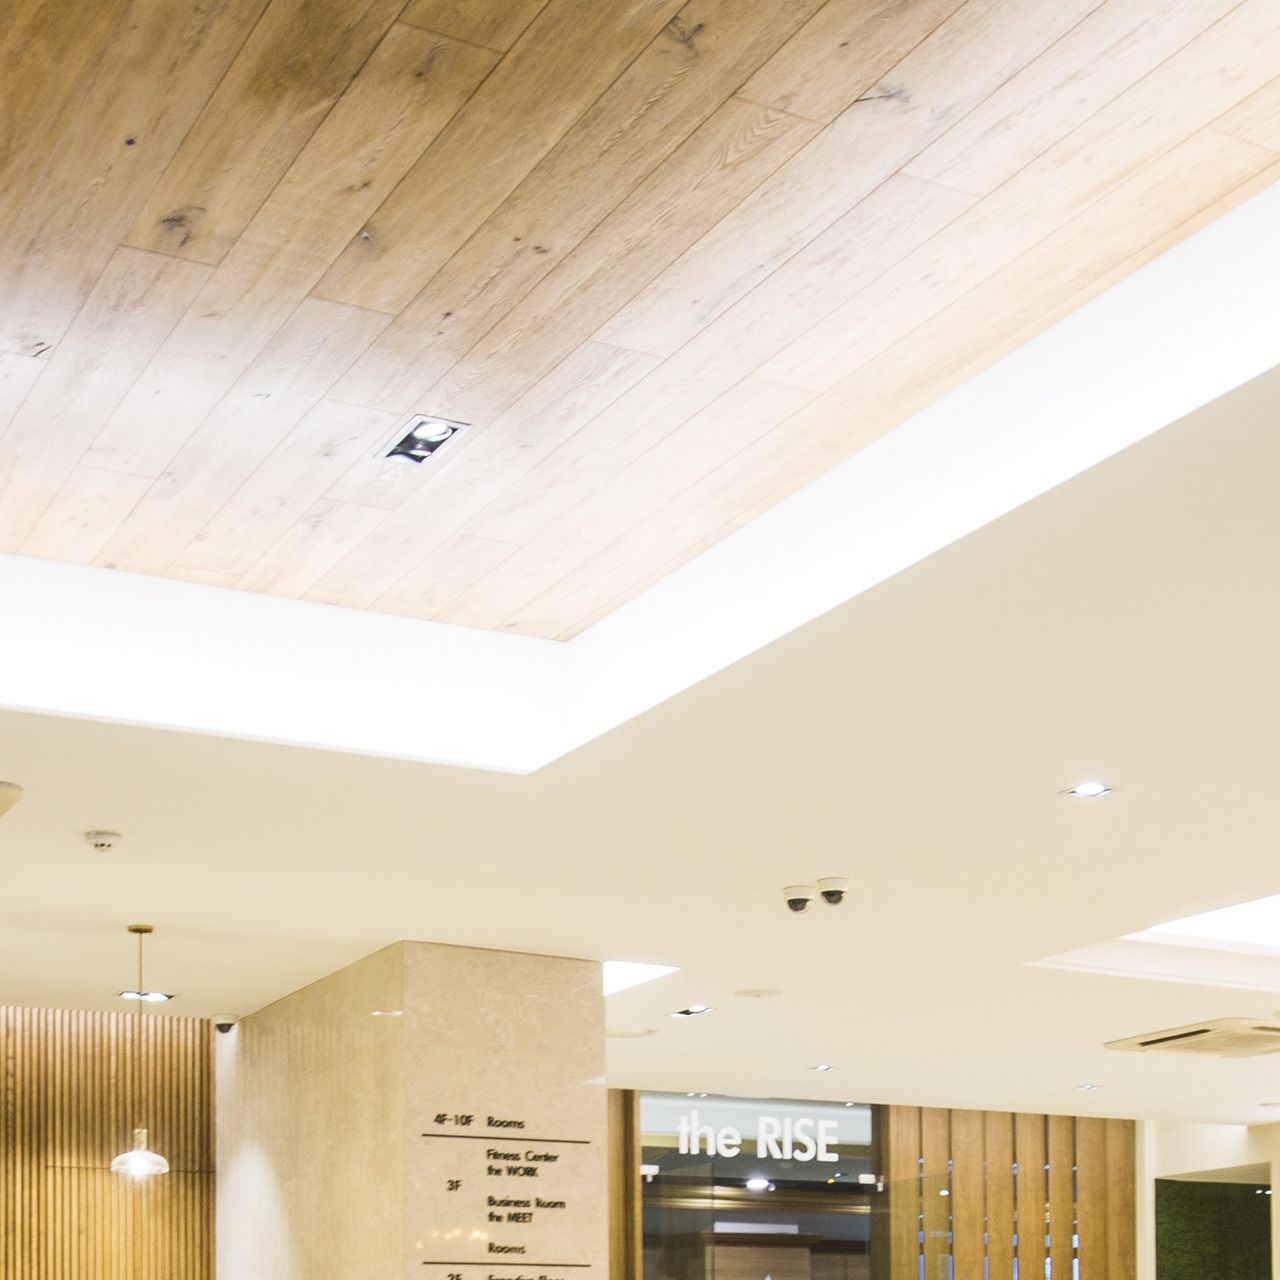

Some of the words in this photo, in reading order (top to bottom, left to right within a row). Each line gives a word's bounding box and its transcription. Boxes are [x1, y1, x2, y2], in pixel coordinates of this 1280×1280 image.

[433, 1114, 474, 1126] 4F-10F
[486, 1116, 525, 1129] Rooms
[676, 1109, 742, 1158] the
[756, 1116, 839, 1162] RISE
[486, 1149, 521, 1161] Fitness
[525, 1150, 559, 1162] Center
[487, 1165, 502, 1176] the
[506, 1166, 538, 1177] WORK
[446, 1180, 462, 1191] 3F
[487, 1196, 531, 1208] Business
[535, 1197, 566, 1209] Room
[488, 1211, 503, 1222] the
[507, 1212, 533, 1223] MEET
[487, 1242, 526, 1254] Rooms
